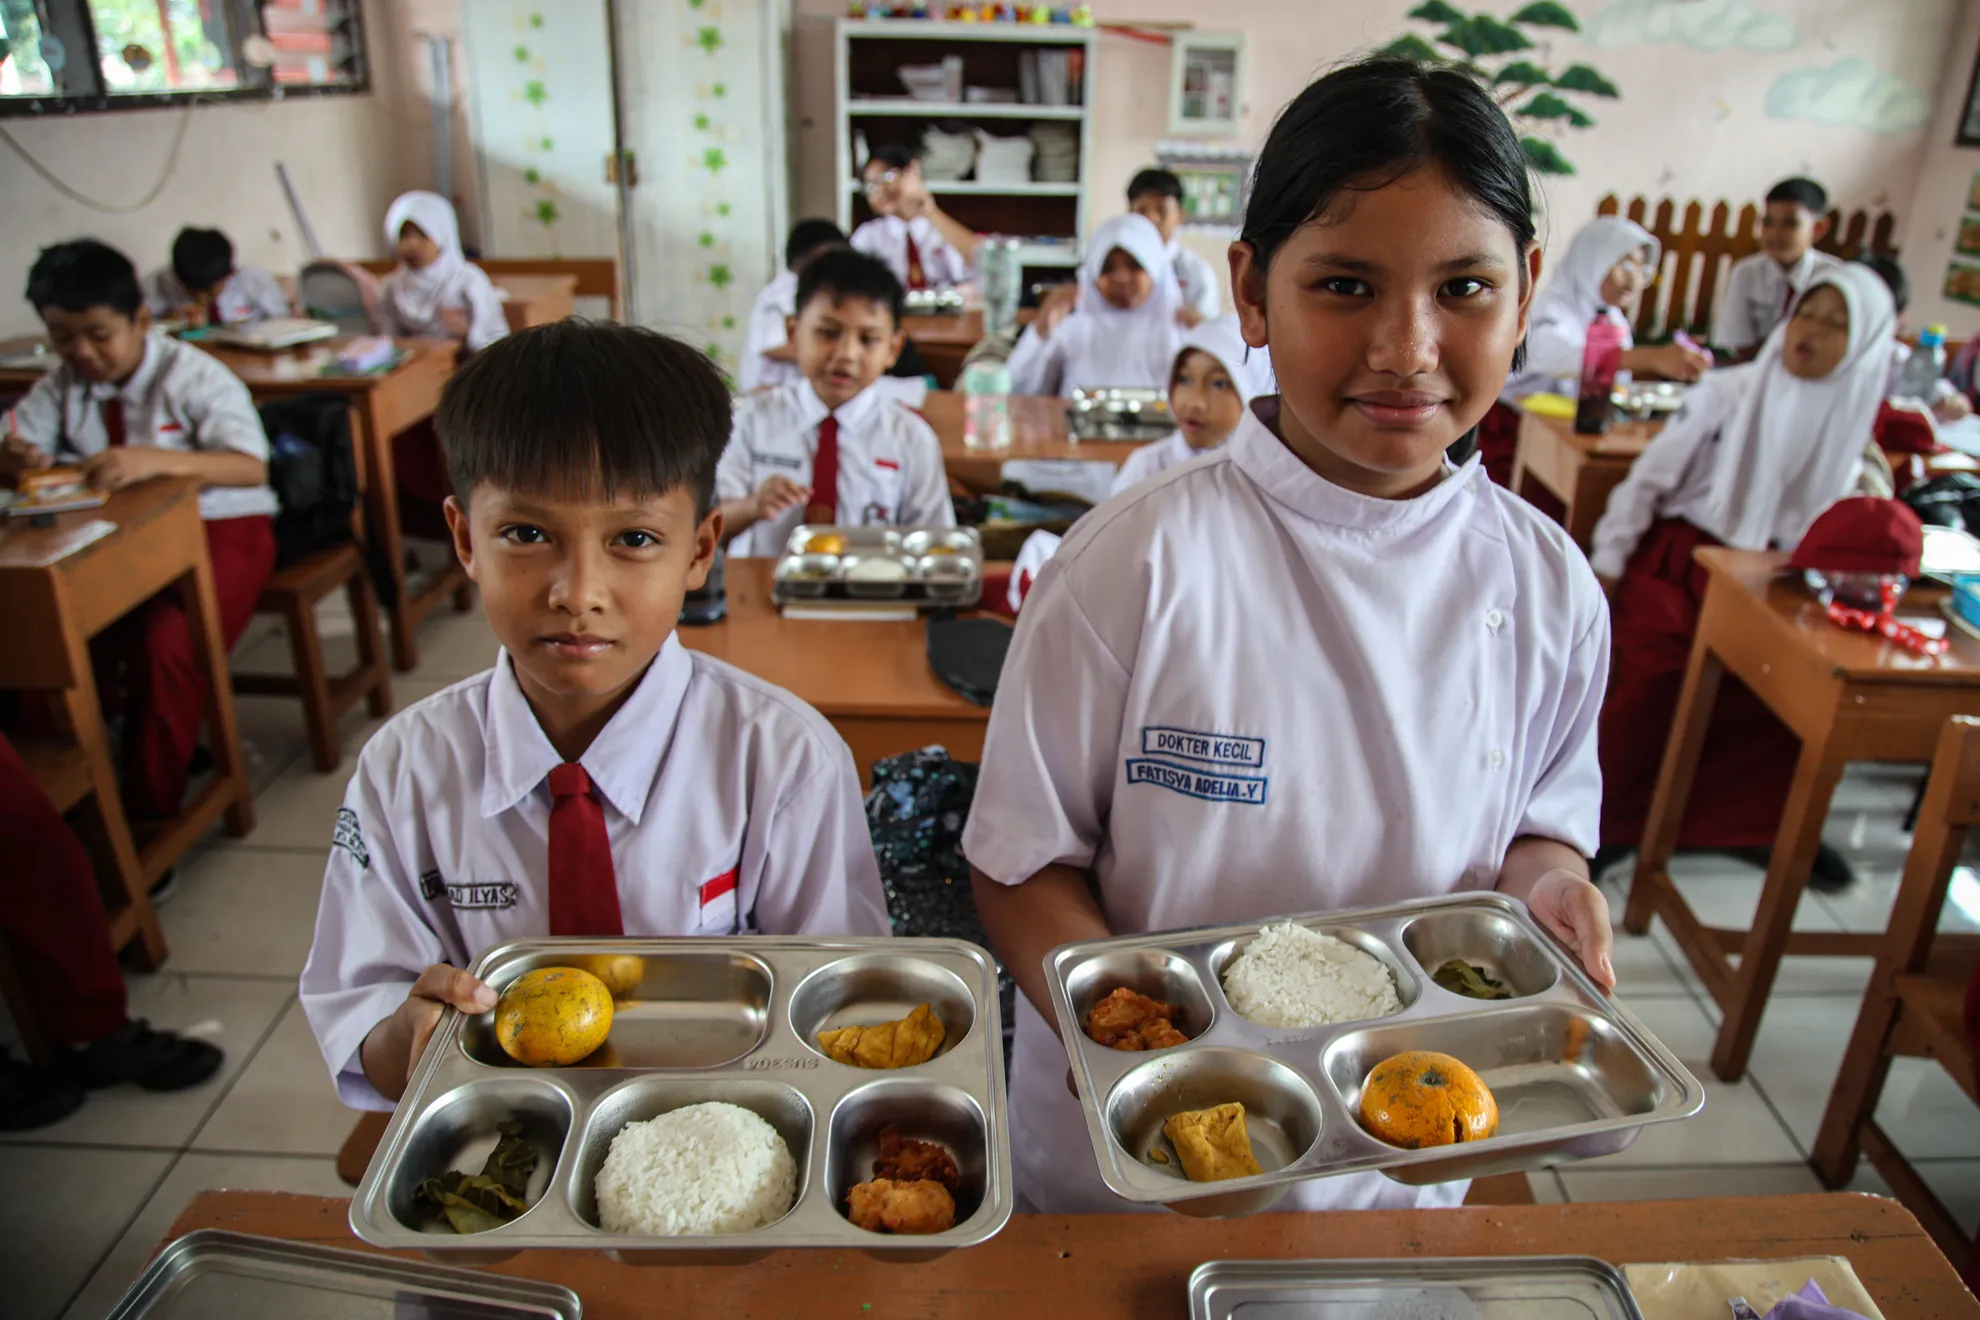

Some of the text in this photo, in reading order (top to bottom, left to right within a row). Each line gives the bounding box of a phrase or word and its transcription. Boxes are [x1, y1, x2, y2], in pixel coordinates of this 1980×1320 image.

[1157, 732, 1253, 761] DOKTER KECIL
[1136, 764, 1193, 791] FATISYA
[468, 885, 510, 904] ILYAS
